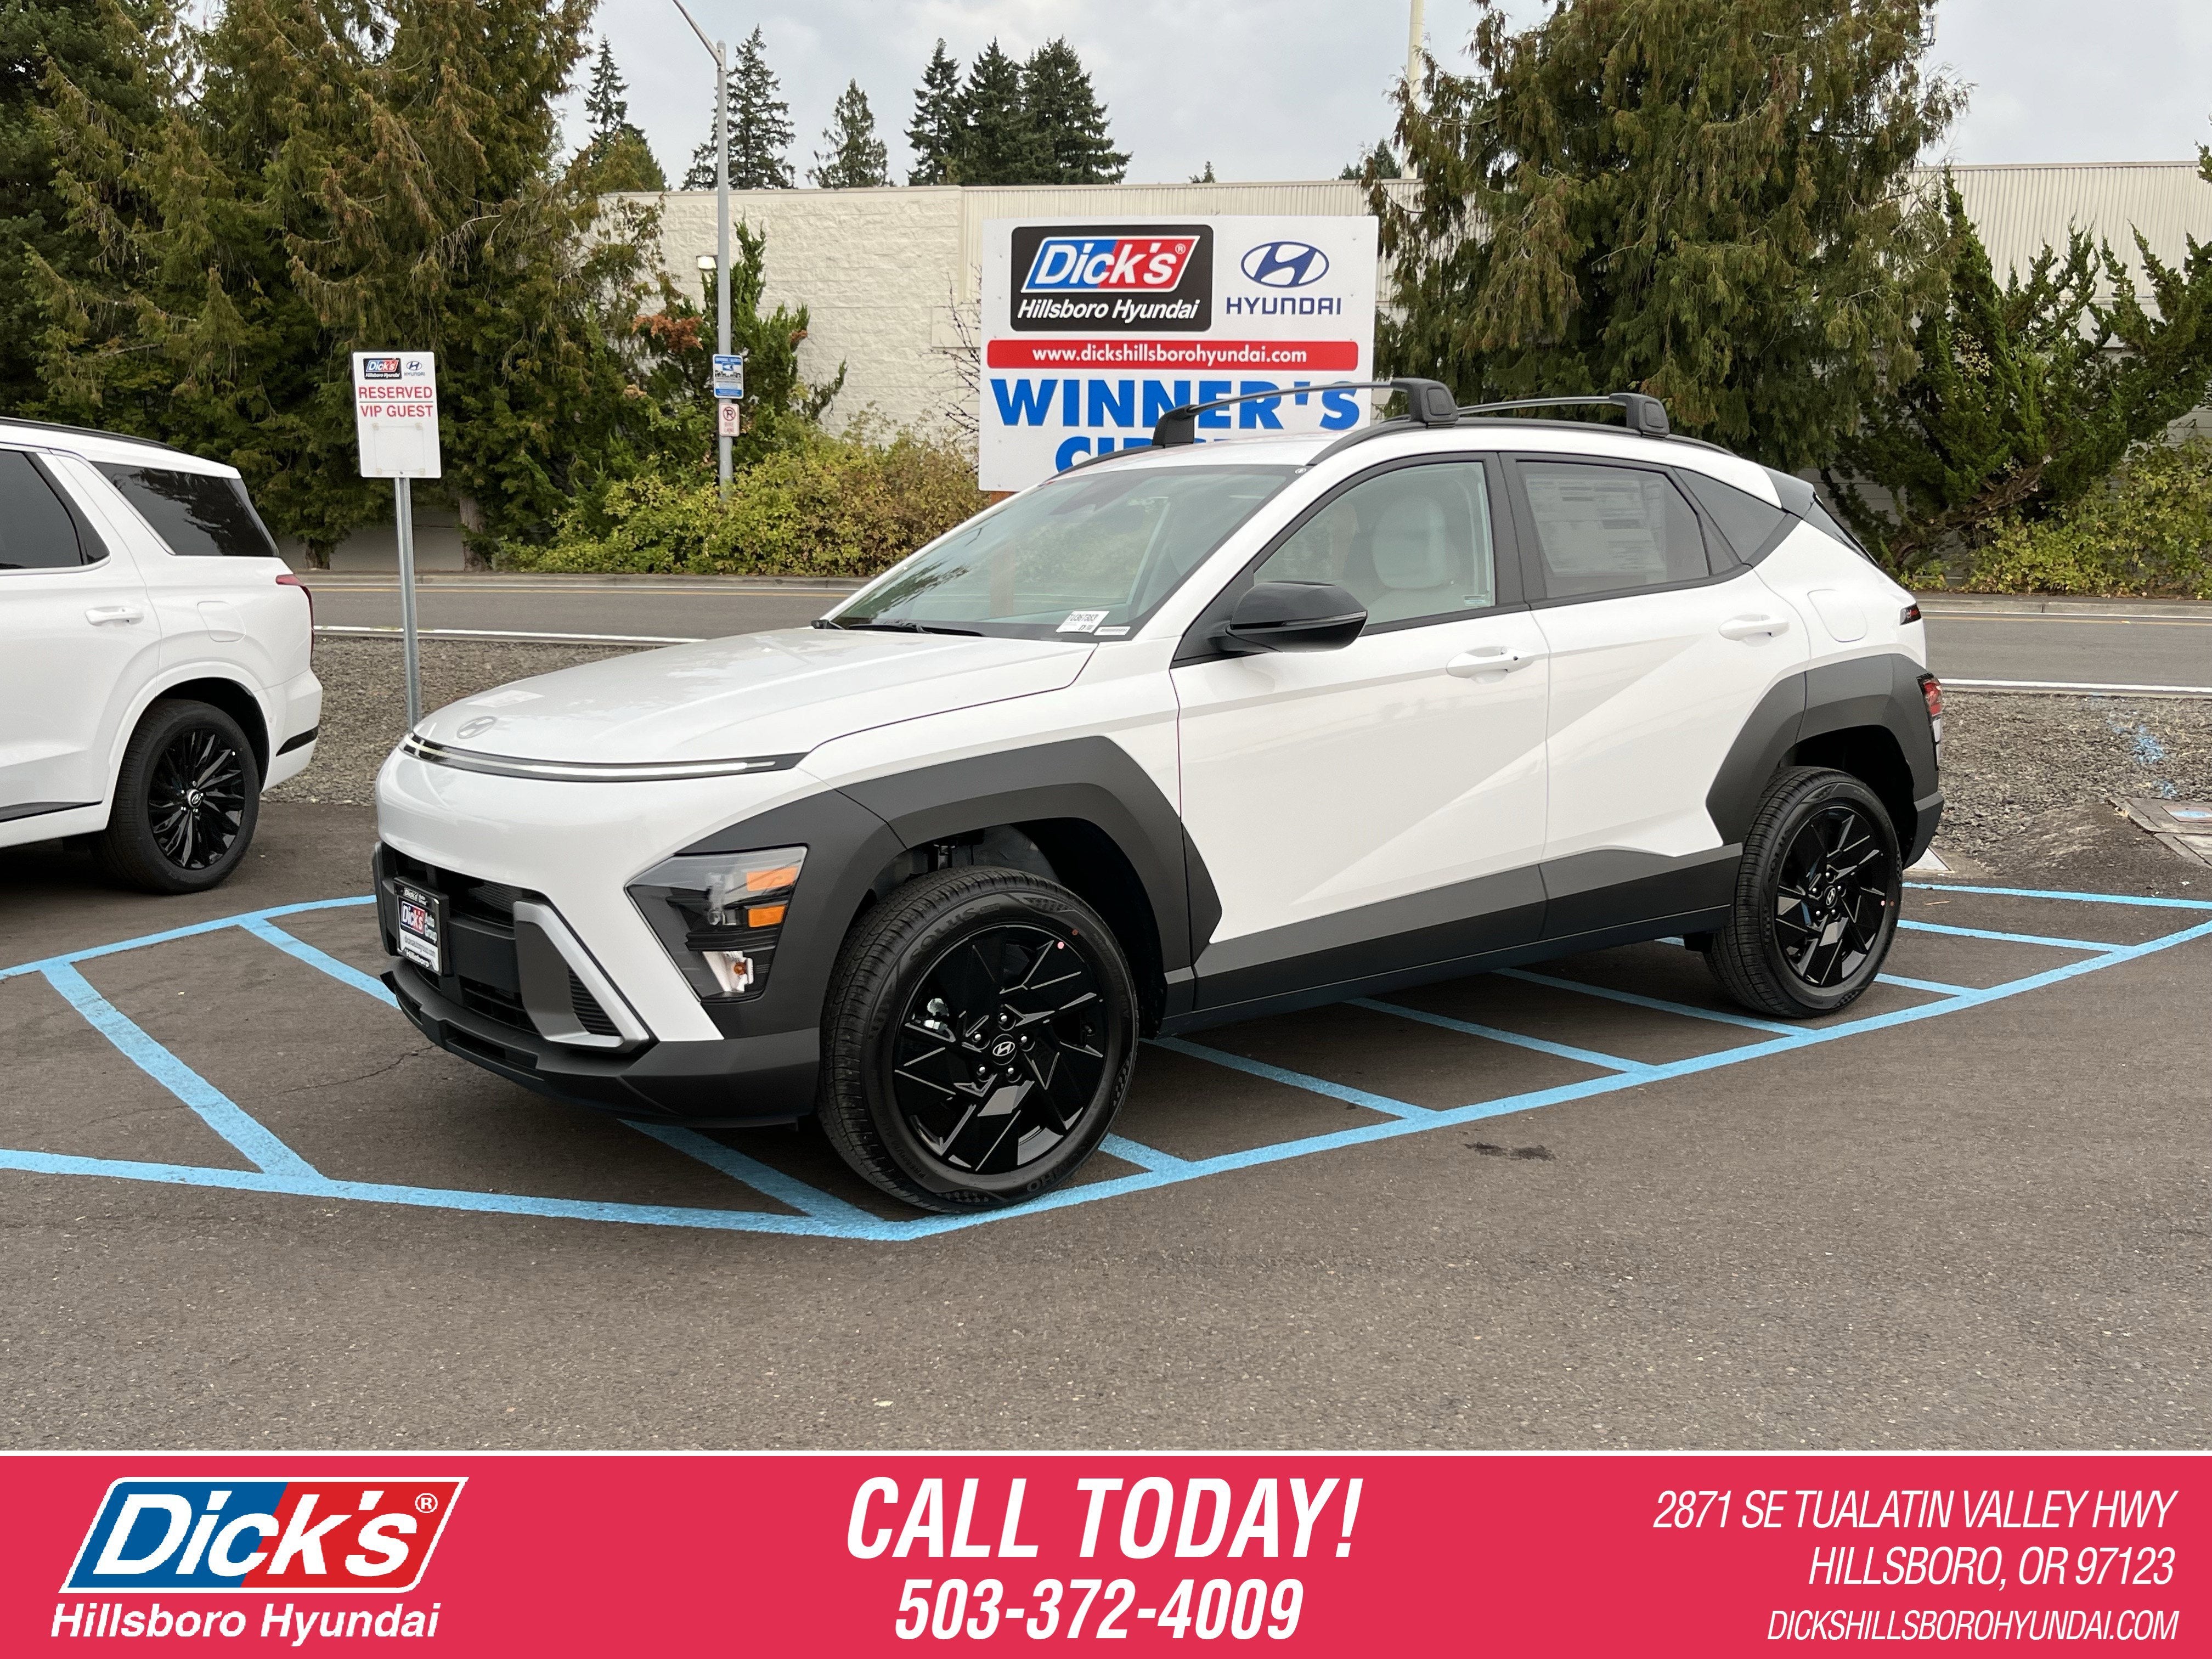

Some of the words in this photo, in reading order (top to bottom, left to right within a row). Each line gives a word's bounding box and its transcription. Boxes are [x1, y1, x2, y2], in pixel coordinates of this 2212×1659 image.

[1035, 242, 1177, 286] Dick's
[1017, 298, 1109, 320] Hillsboro
[1111, 299, 1200, 324] Hyundai
[1226, 297, 1342, 315] HYUNDAI
[368, 360, 396, 371] Dick's
[1032, 343, 1307, 367] www.dickshillsborohyundai.com
[358, 386, 433, 399] RESERVED
[990, 378, 1361, 430] WINNER'S
[360, 405, 382, 417] VIP
[386, 405, 434, 417] GUEST
[403, 905, 424, 930] Dick's
